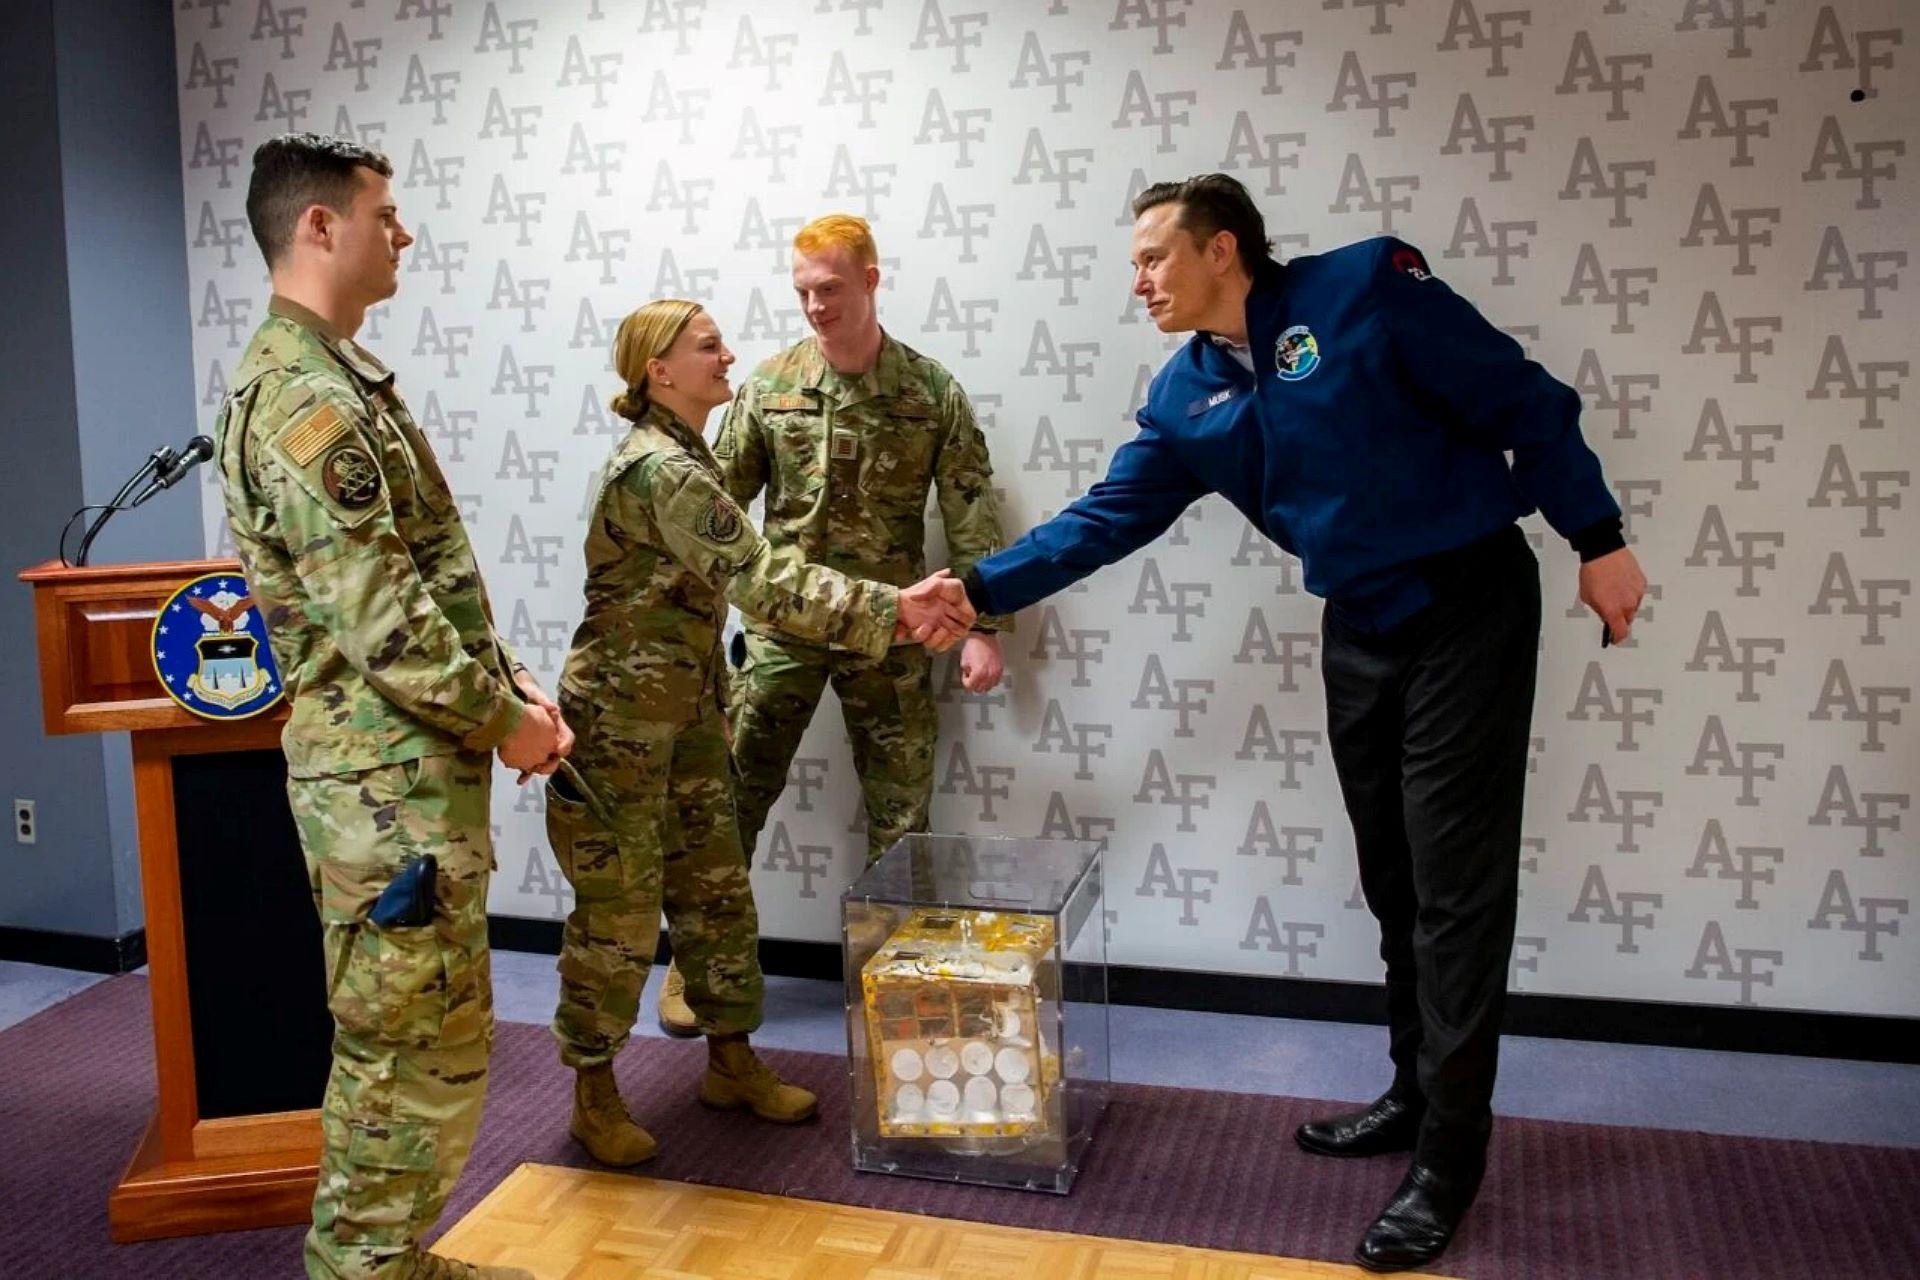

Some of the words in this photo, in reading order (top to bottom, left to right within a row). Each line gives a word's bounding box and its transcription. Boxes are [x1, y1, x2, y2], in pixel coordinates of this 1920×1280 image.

[250, 0, 306, 59] AF
[324, 22, 382, 91] AF
[474, 1, 538, 73] AF
[726, 15, 798, 91] AF
[910, 0, 988, 73] AF
[1216, 10, 1303, 95] AF
[1437, 0, 1531, 77] AF
[1799, 6, 1903, 98] AF
[185, 42, 239, 108] AF
[255, 72, 311, 132] AF
[399, 54, 460, 125] AF
[557, 35, 622, 108] AF
[641, 70, 711, 144] AF
[818, 51, 893, 129] AF
[1009, 31, 1090, 113] AF
[1112, 70, 1196, 153] AF
[1326, 51, 1416, 137] AF
[1555, 31, 1652, 121] AF
[189, 122, 243, 188] AF
[478, 88, 542, 160] AF
[561, 122, 626, 197] AF
[730, 106, 802, 183] AF
[914, 88, 991, 168] AF
[1220, 111, 1306, 195] AF
[1440, 93, 1534, 181] AF
[1677, 75, 1778, 167] AF
[404, 138, 464, 210] AF
[646, 159, 714, 234] AF
[822, 144, 897, 220] AF
[1012, 127, 1093, 209] AF
[1329, 153, 1420, 235] AF
[1558, 137, 1655, 227] AF
[1802, 116, 1905, 210] AF
[193, 201, 247, 267] AF
[482, 174, 546, 246] AF
[564, 211, 630, 284] AF
[734, 197, 805, 274] AF
[917, 183, 995, 263] AF
[1443, 198, 1537, 285] AF
[1680, 183, 1780, 275] AF
[407, 222, 469, 294] AF
[486, 259, 550, 332] AF
[1016, 224, 1097, 305] AF
[1561, 244, 1657, 334] AF
[1804, 226, 1907, 319] AF
[199, 280, 251, 347] AF
[413, 307, 473, 378] AF
[921, 277, 998, 357] AF
[1682, 291, 1782, 383] AF
[202, 359, 231, 405] A
[491, 345, 554, 418] AF
[1020, 320, 1100, 402] AF
[1208, 389, 1231, 408] MUSK
[1575, 349, 1659, 439] AF
[1806, 335, 1909, 429] AF
[495, 430, 558, 503] AF
[1023, 415, 1103, 497] AF
[1684, 398, 1783, 490] AF
[1611, 480, 1661, 544] F
[1807, 444, 1910, 537] AF
[500, 514, 564, 588] AF
[1685, 505, 1784, 597] AF
[509, 598, 568, 672] AF
[1128, 559, 1211, 642] AF
[1808, 552, 1910, 645] AF
[1029, 606, 1110, 687] AF
[1233, 607, 1319, 692] AF
[1685, 611, 1784, 702] AF
[1131, 654, 1214, 737] AF
[1567, 662, 1662, 751] AF
[1809, 659, 1910, 752] AF
[1033, 699, 1112, 780] AF
[1235, 705, 1320, 789] AF
[1685, 715, 1784, 806] AF
[787, 758, 829, 811] F
[939, 742, 1015, 821] AF
[1133, 749, 1216, 832] AF
[1567, 764, 1663, 853] AF
[1808, 765, 1910, 857] AF
[762, 821, 832, 898] AF
[1237, 801, 1322, 885] AF
[1685, 819, 1784, 910] AF
[1136, 843, 1218, 926] AF
[1568, 865, 1662, 954] AF
[1808, 870, 1908, 961] AF
[1239, 895, 1324, 975] AF
[1684, 921, 1783, 1006] AF
